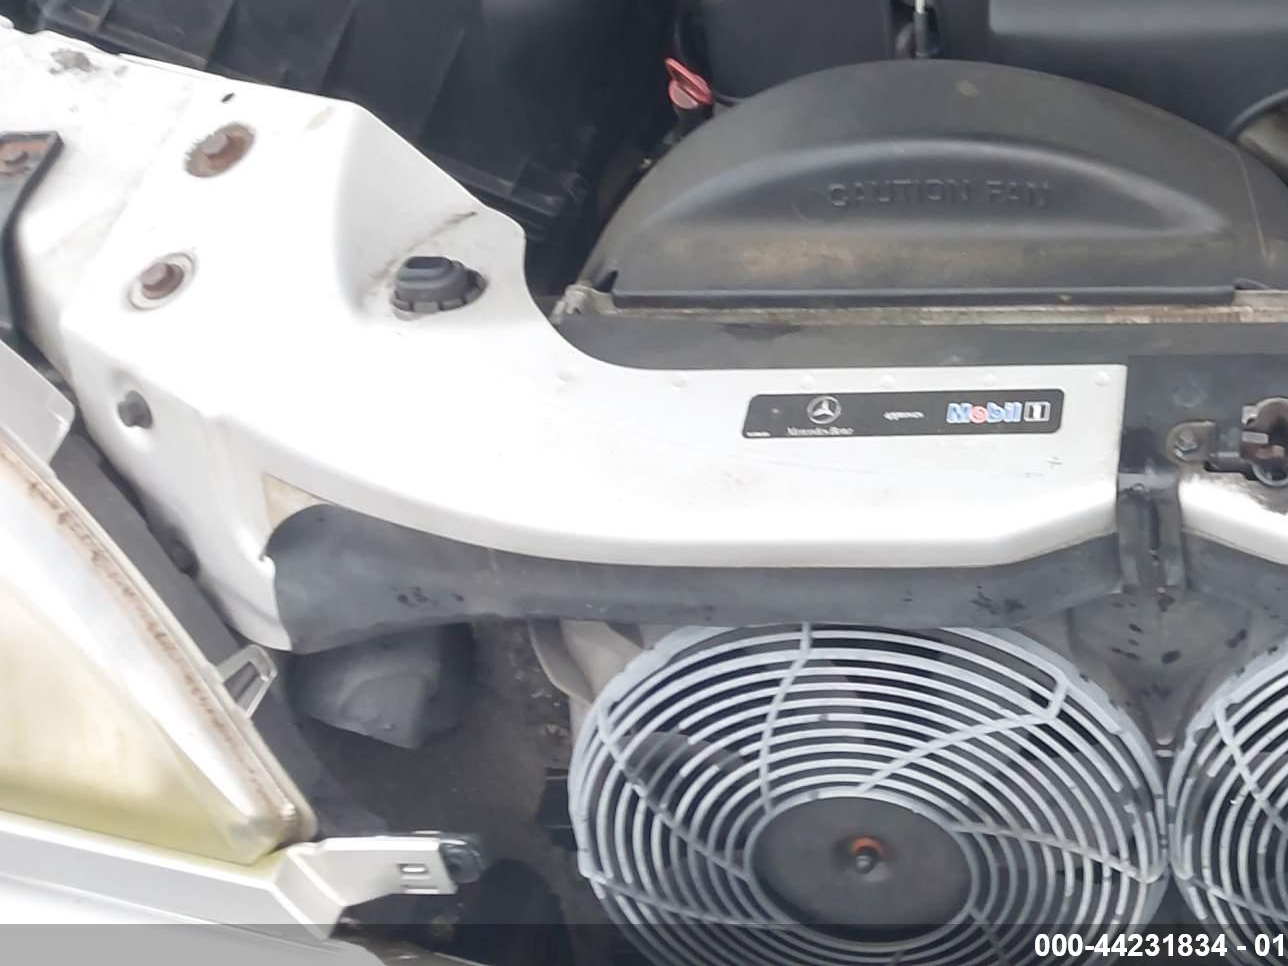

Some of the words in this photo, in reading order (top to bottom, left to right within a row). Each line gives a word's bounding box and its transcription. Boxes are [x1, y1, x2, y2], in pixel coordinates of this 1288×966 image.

[828, 177, 970, 207] CAUTION
[986, 179, 1050, 209] FAN
[946, 400, 1023, 424] Mobil
